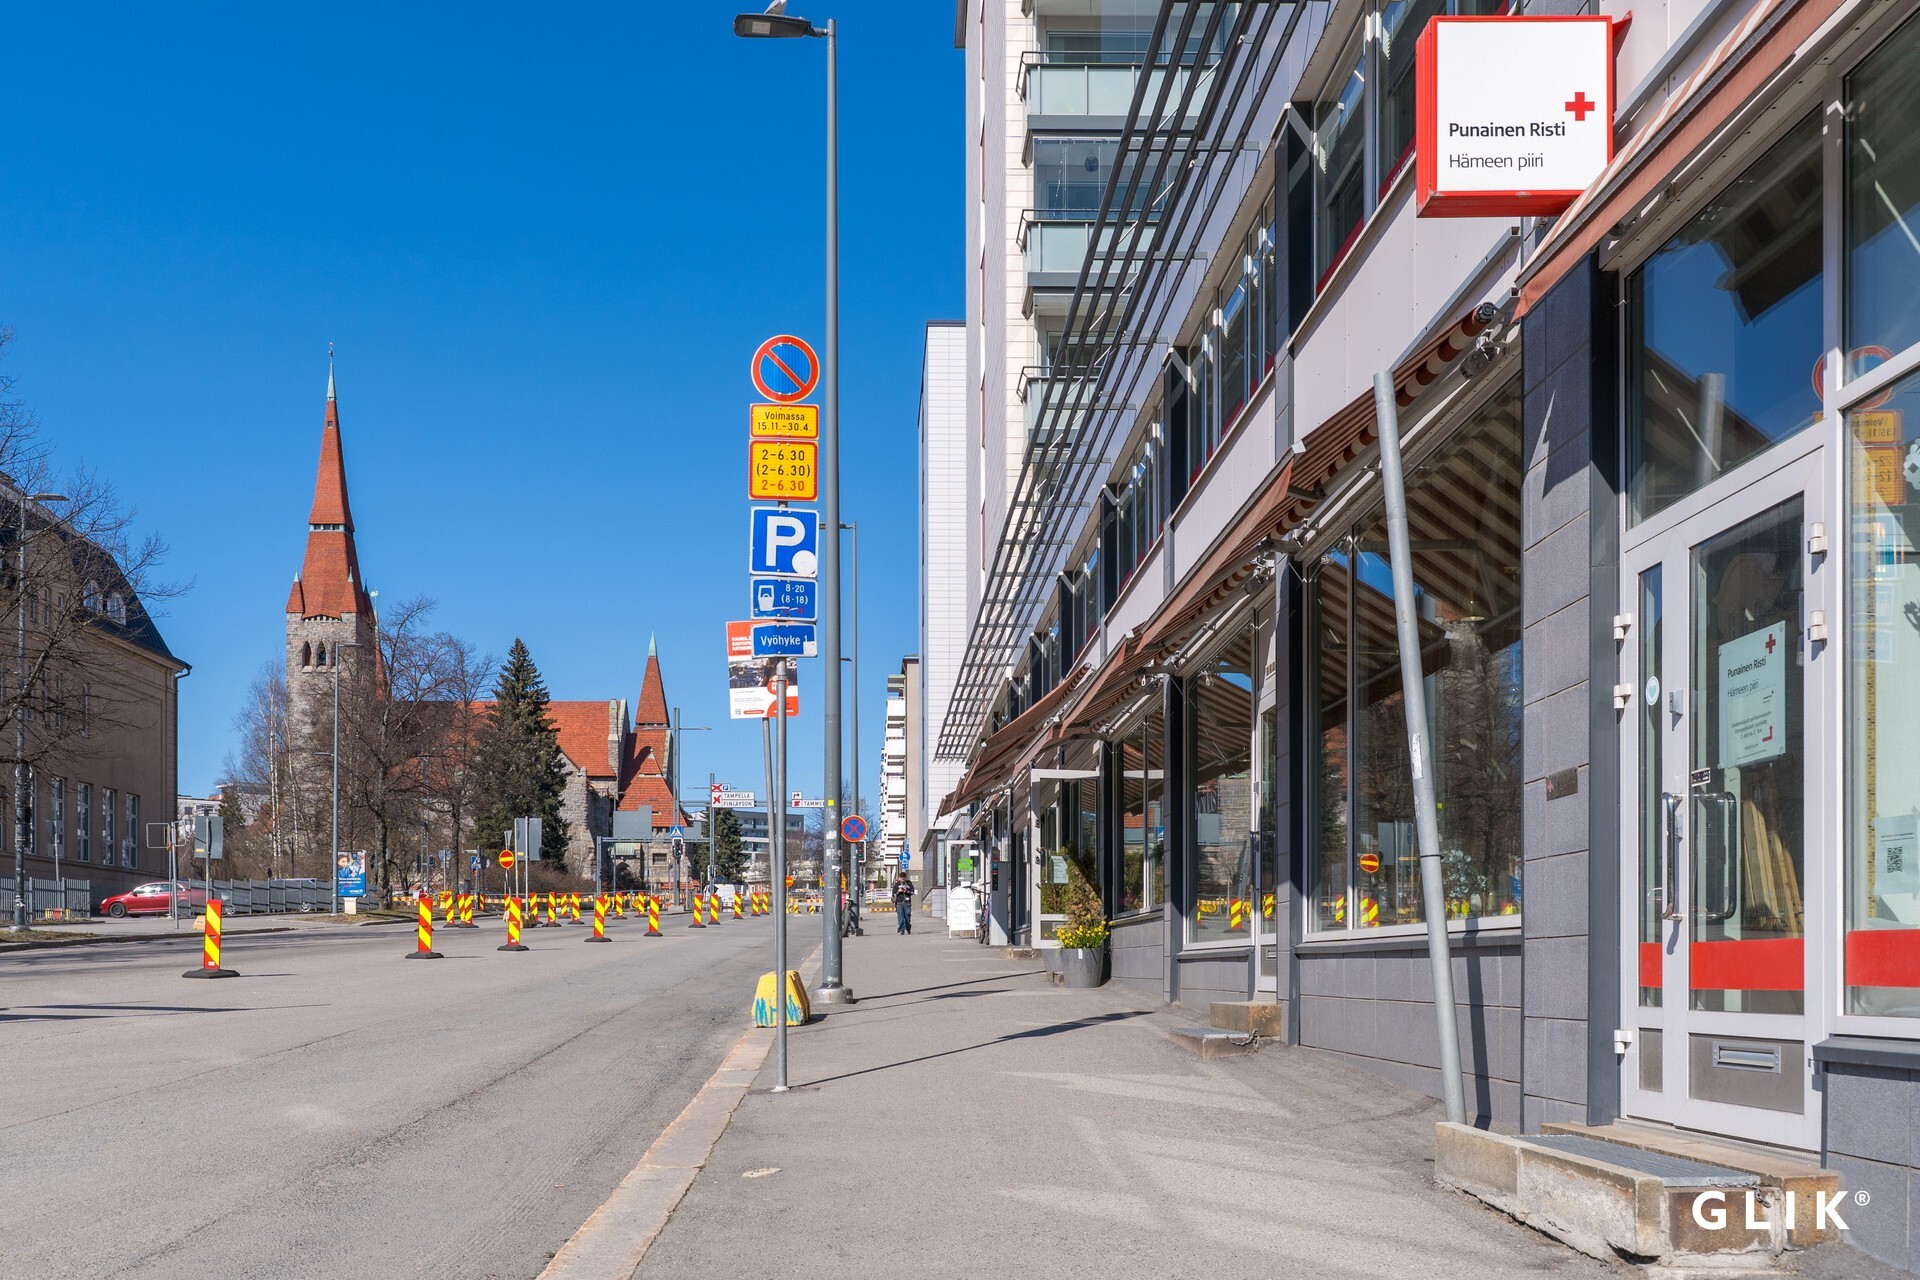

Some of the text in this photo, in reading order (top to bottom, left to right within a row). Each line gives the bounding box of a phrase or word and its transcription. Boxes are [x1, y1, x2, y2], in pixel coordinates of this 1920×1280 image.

[1449, 121, 1566, 137] Punainen Risti
[1449, 153, 1544, 171] Hämeen piiri
[764, 411, 805, 421] Voimassa
[757, 422, 812, 432] 15.11.-30.4.
[762, 449, 805, 461] 2-6.30
[756, 464, 811, 478] (2-6.30)
[761, 479, 805, 491] 2-6.30
[765, 515, 806, 567] P
[785, 583, 805, 593] 8-20
[781, 594, 809, 605] (8-18)
[760, 635, 801, 647] Vyöhyke
[1727, 656, 1767, 679] Punainen Risti
[1727, 684, 1749, 698] Hämeen
